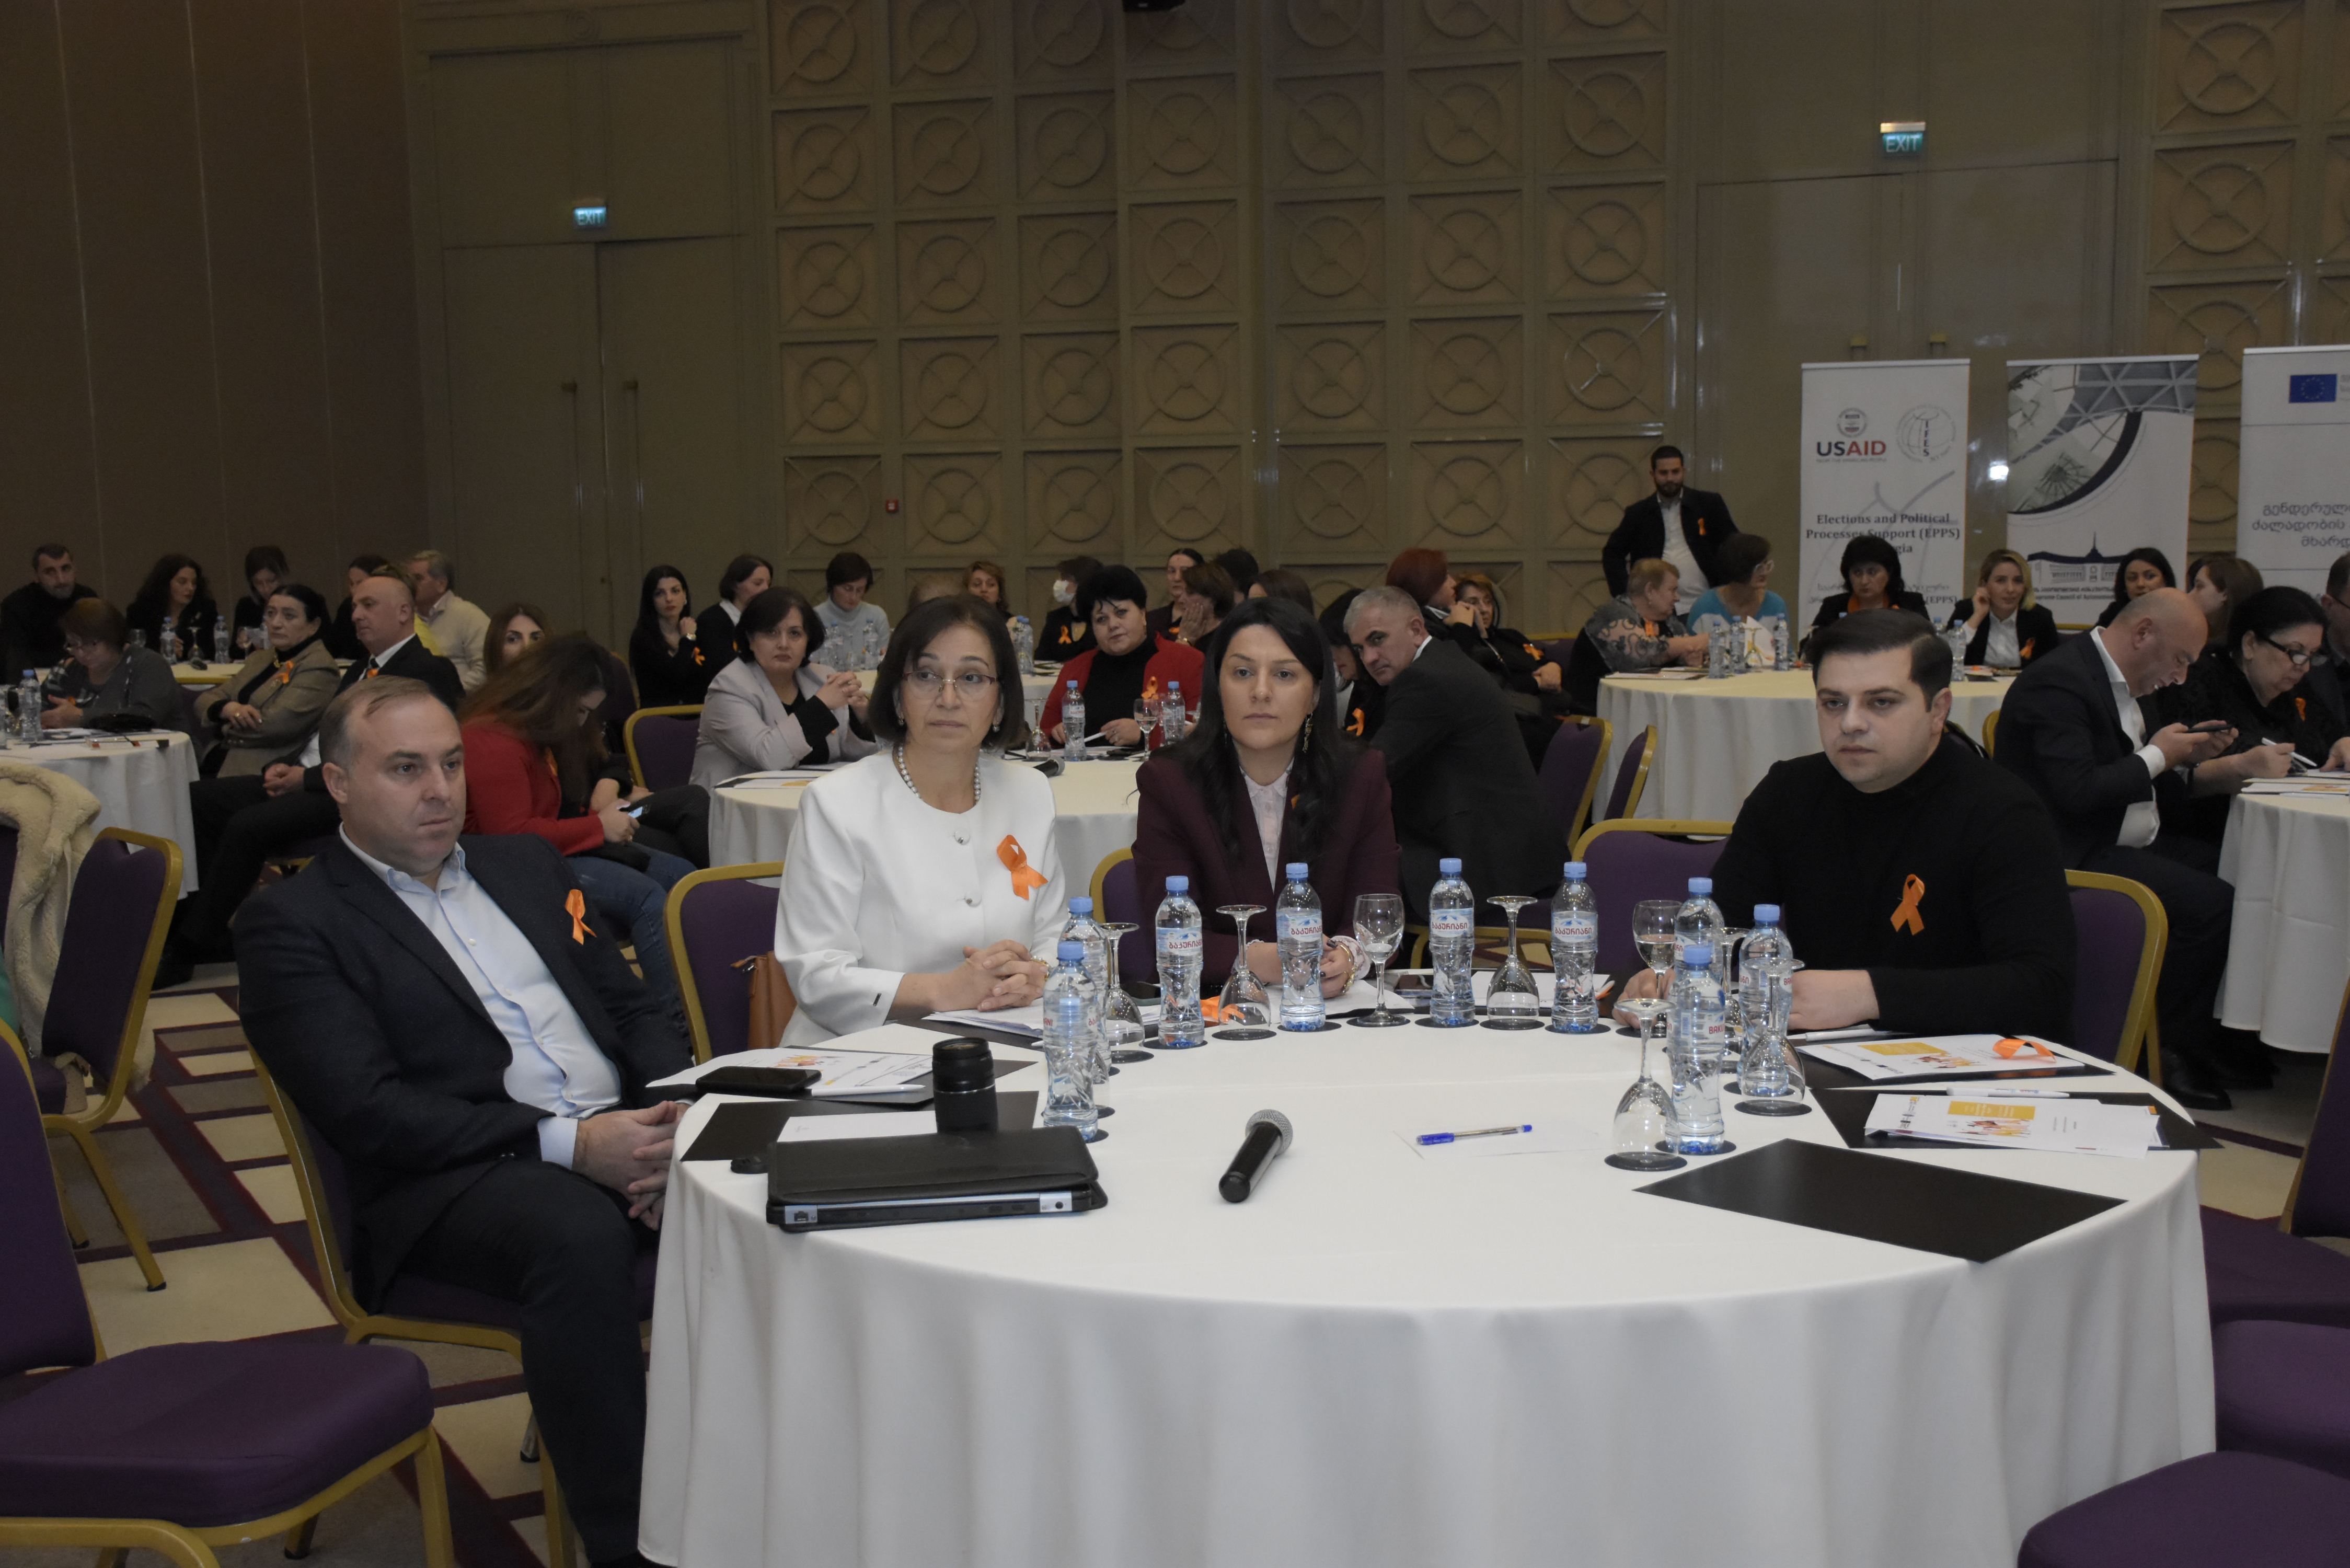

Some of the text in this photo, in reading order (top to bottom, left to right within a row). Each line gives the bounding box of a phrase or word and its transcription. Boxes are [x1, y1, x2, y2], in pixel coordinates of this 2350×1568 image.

[1886, 135, 1920, 153] EXIT
[578, 210, 603, 226] EXIT
[1816, 440, 1887, 456] USAID
[2263, 502, 2350, 516] გენდერულ
[1816, 513, 1950, 524] Elections and Political
[2252, 519, 2346, 533] ძალადობის
[1919, 528, 1961, 540] (EPPS)
